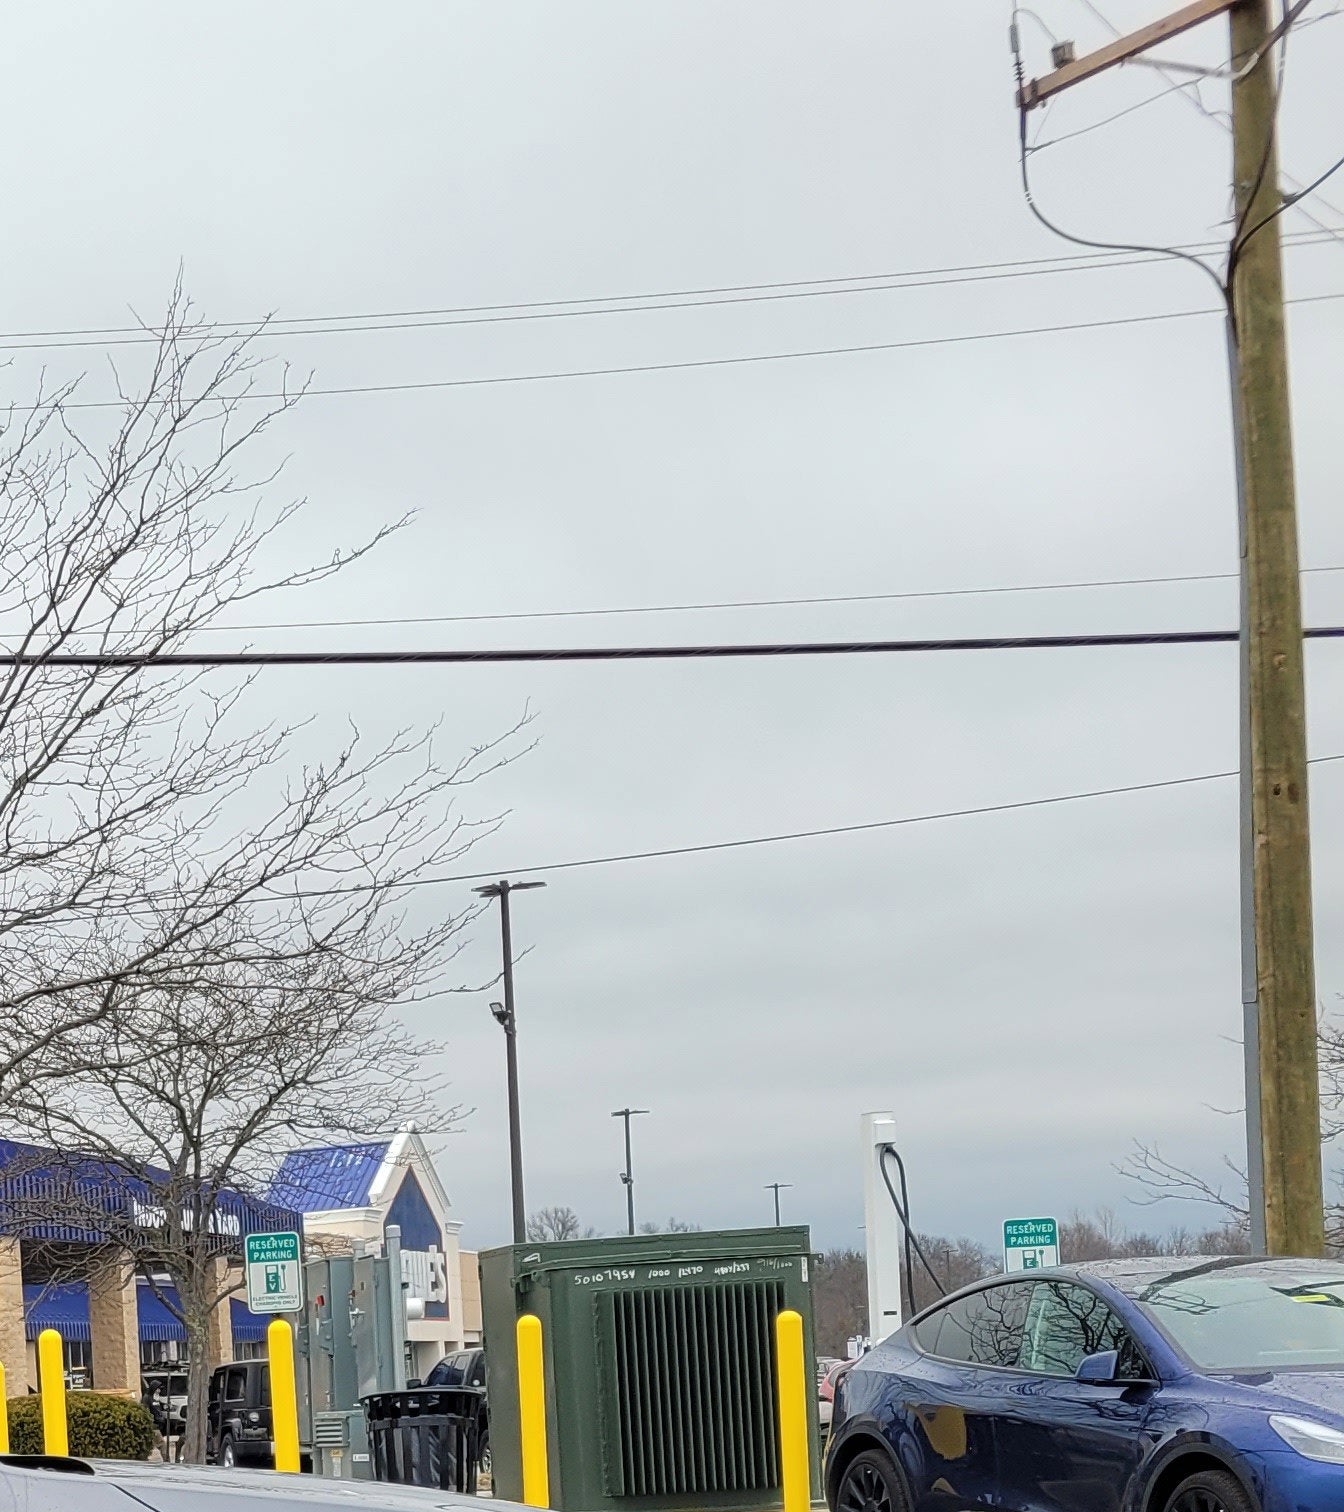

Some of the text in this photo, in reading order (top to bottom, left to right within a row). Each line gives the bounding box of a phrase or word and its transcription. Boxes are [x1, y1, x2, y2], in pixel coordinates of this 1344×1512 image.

[1006, 1223, 1054, 1234] RESERVED
[250, 1239, 295, 1250] RESERVED
[1010, 1235, 1051, 1245] PARKING
[253, 1250, 293, 1260] PARKING
[648, 1269, 670, 1279] 1000
